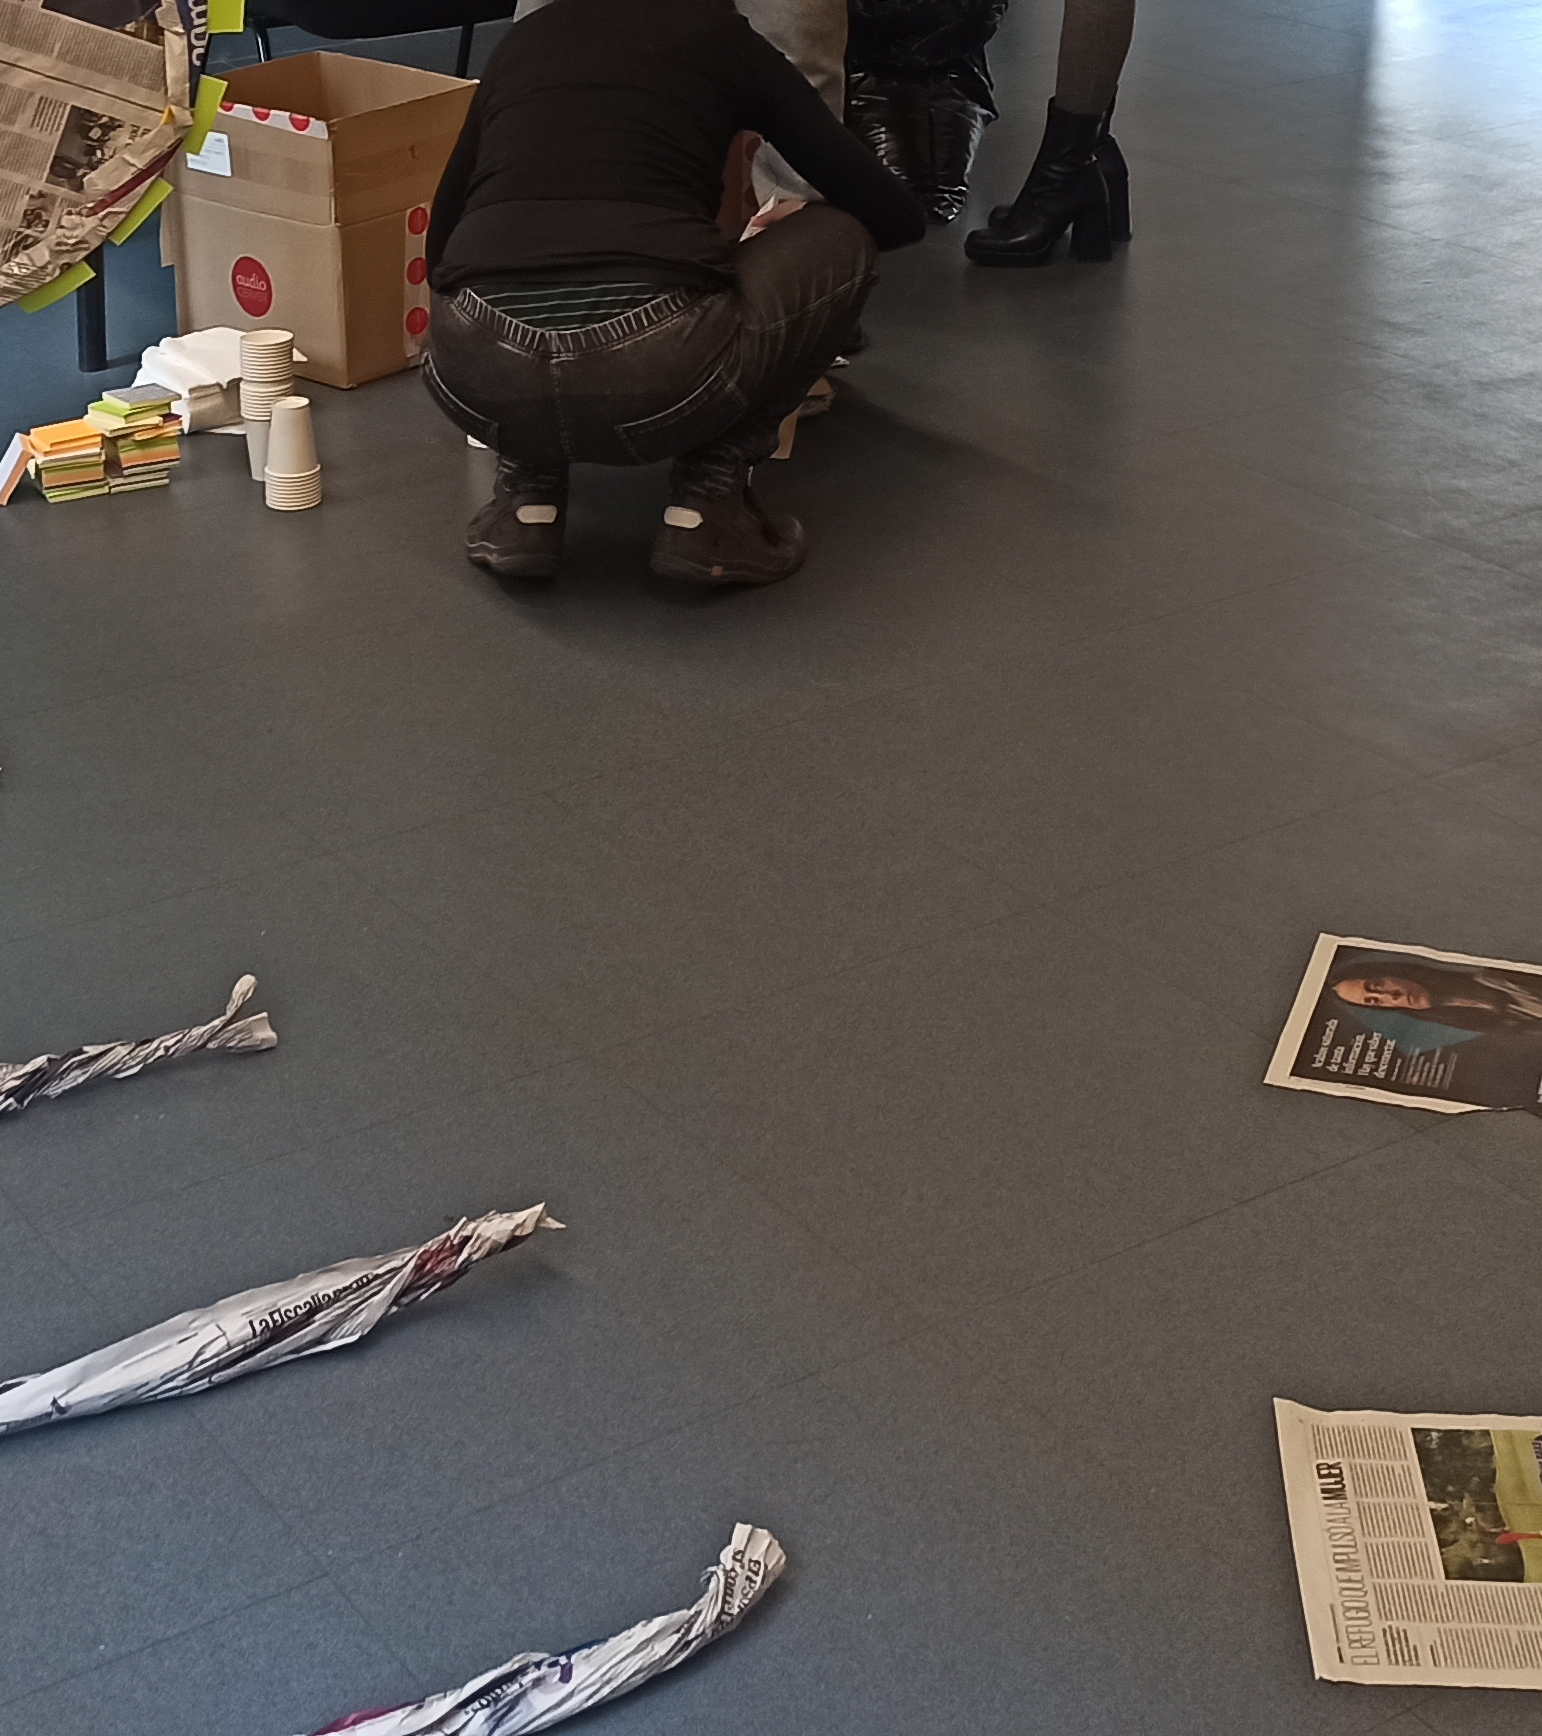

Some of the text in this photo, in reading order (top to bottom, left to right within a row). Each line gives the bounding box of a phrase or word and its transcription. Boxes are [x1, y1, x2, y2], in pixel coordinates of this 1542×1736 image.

[1315, 1460, 1348, 1503] MUJER
[1335, 1571, 1368, 1600] QUE
[1340, 1596, 1376, 1651] REFUGIO
[1349, 1650, 1380, 1668] EL
